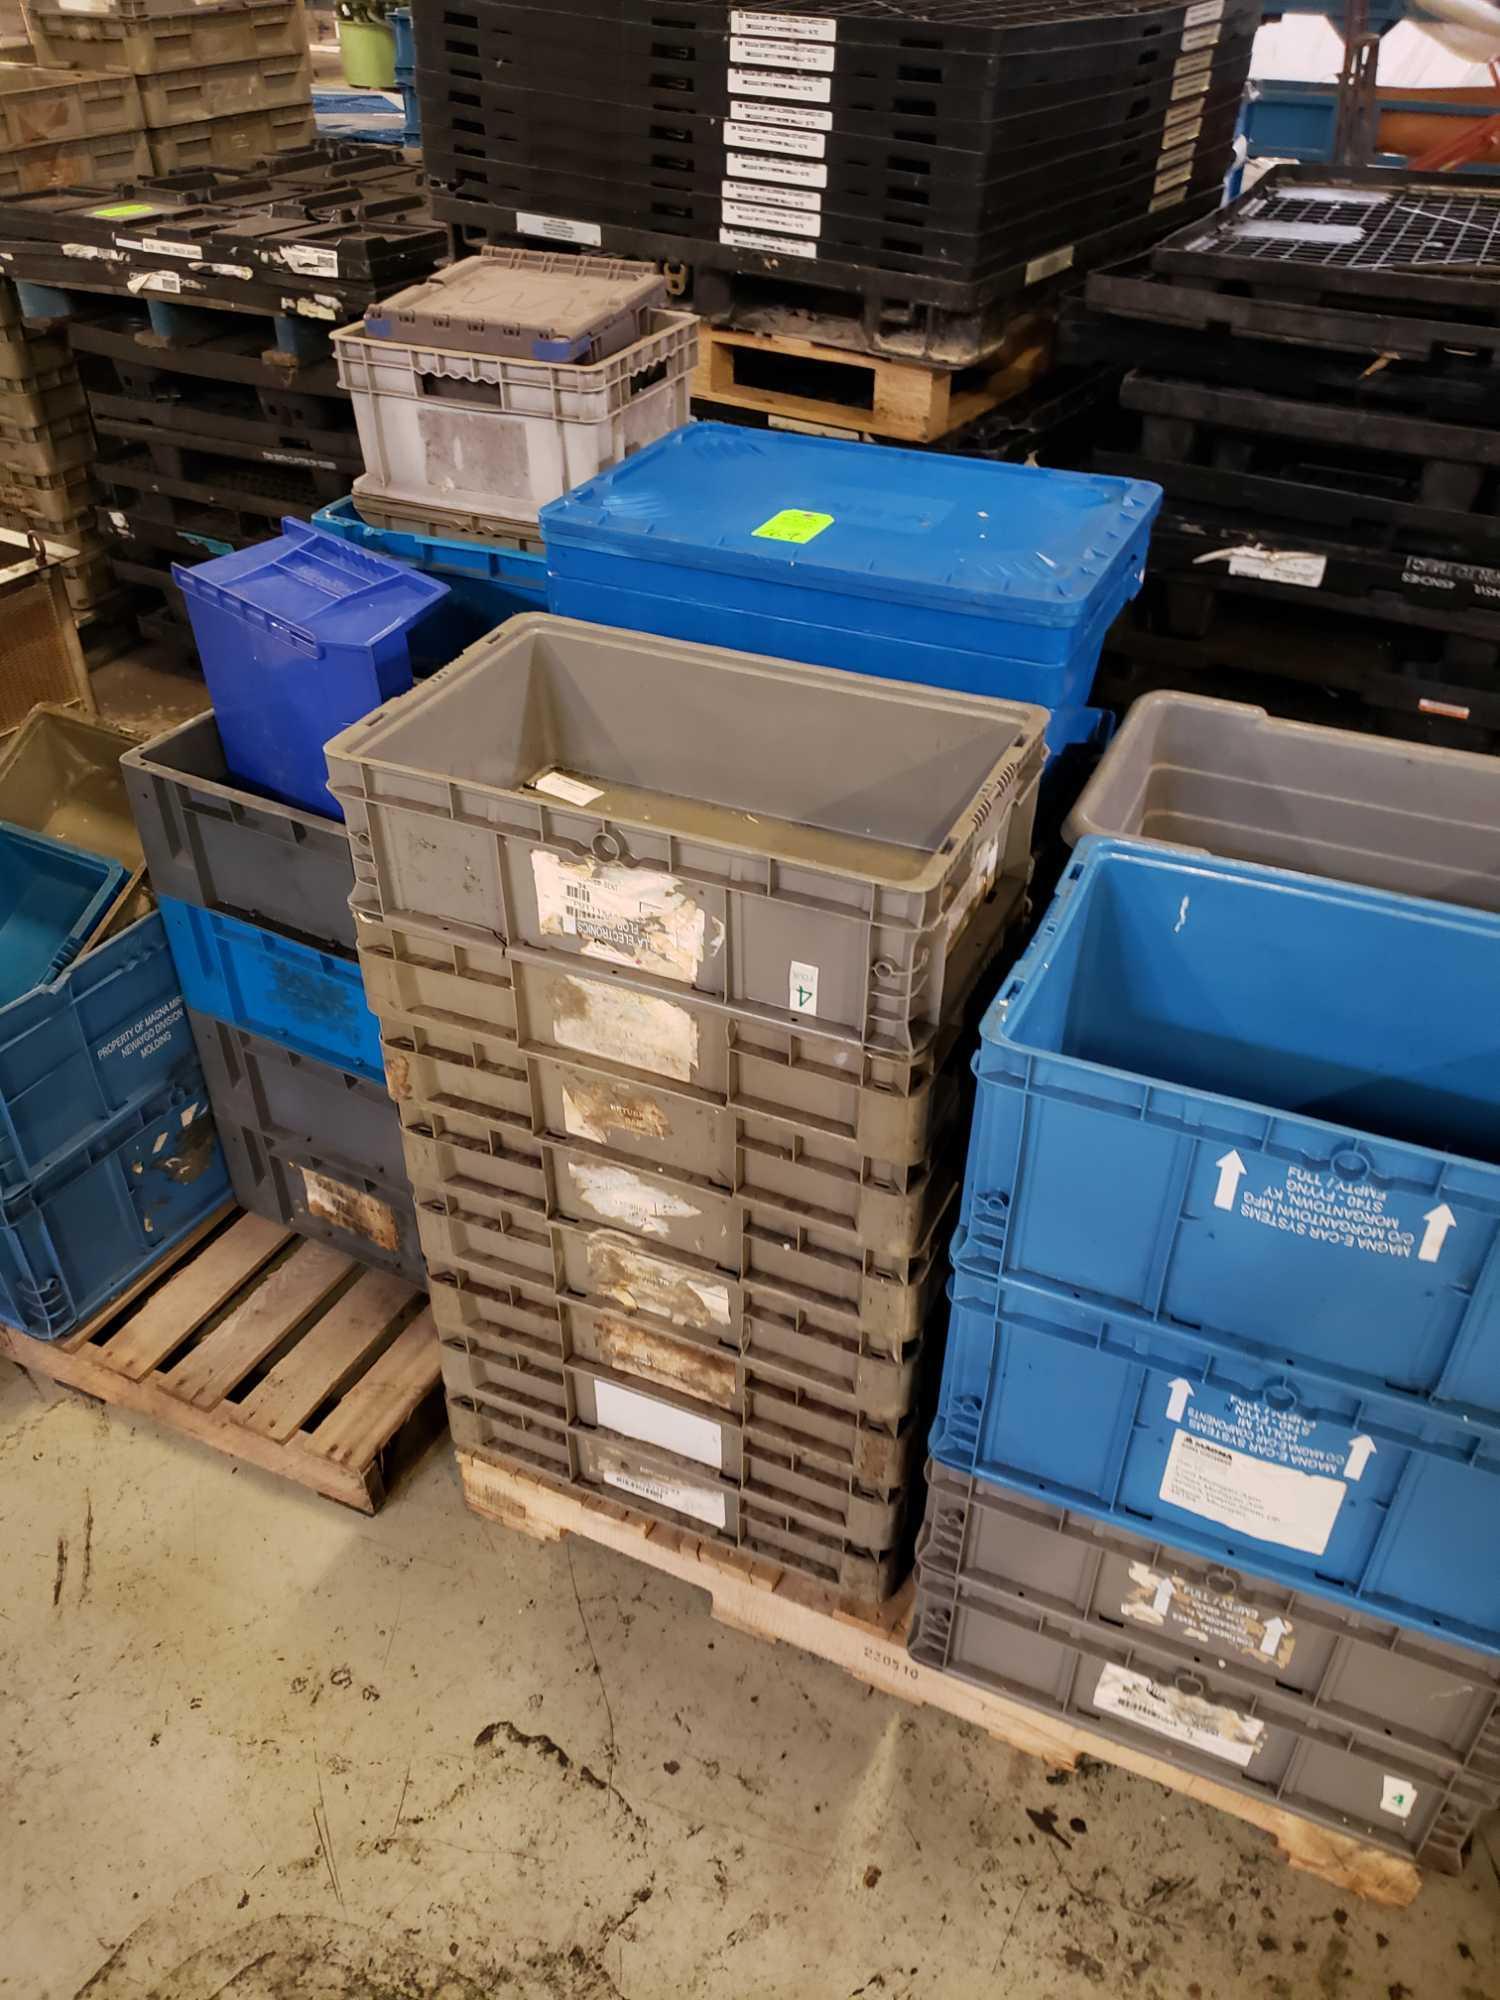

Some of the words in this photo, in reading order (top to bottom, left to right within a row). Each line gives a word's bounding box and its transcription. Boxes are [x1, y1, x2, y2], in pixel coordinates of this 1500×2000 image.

[577, 921, 633, 945] ELECTRONICS
[796, 985, 813, 1007] 4
[97, 1027, 133, 1060] PROPERTY
[134, 1020, 144, 1034] OF
[144, 1004, 170, 1026] MAGNA
[140, 1031, 172, 1058] MOLDING
[1288, 1166, 1322, 1186] FULL
[1264, 1186, 1283, 1201] KY
[1286, 1179, 1335, 1202] FYYNG
[1243, 1192, 1274, 1212] MFG
[1348, 1197, 1383, 1213] ST40
[1240, 1203, 1307, 1235] SYSTEMS
[1277, 1202, 1385, 1239] MORGANTOWN
[1310, 1225, 1354, 1247] E-CAR
[1358, 1238, 1411, 1258] MAGNA
[1189, 1418, 1246, 1449] SYSTEMS
[1249, 1443, 1288, 1463] E-CAR
[1291, 1454, 1337, 1474] MAGNA
